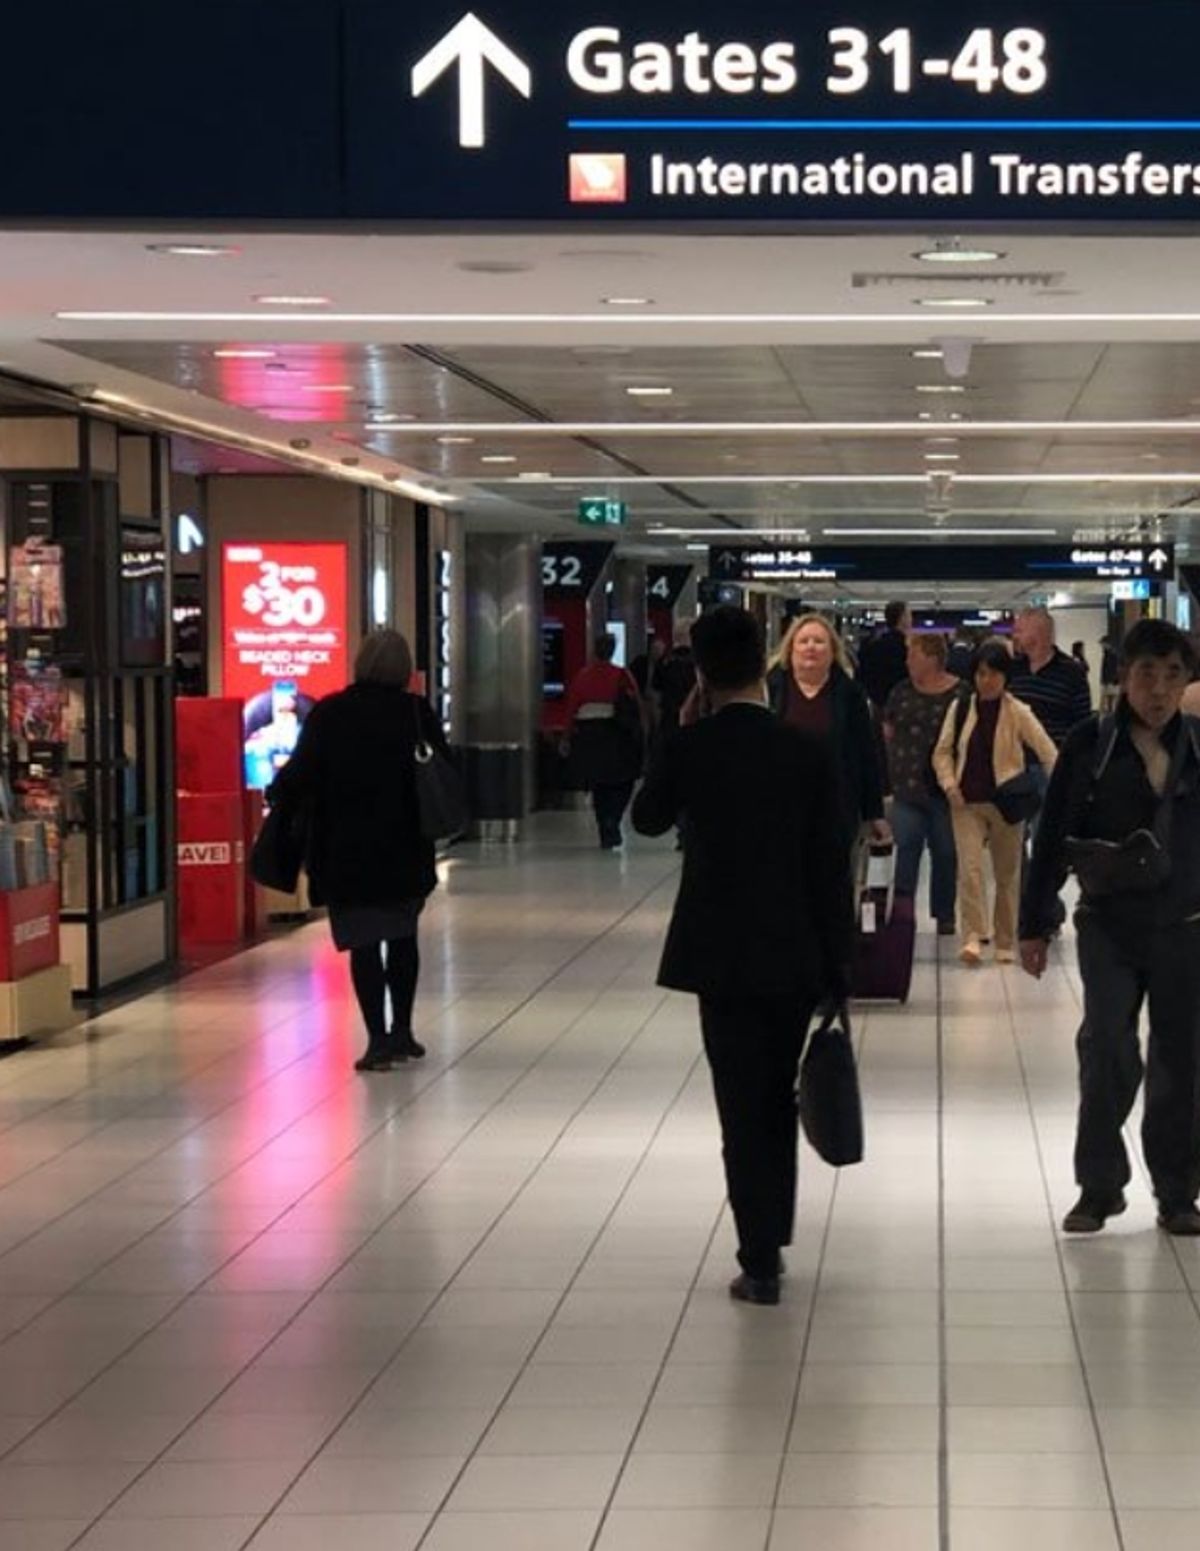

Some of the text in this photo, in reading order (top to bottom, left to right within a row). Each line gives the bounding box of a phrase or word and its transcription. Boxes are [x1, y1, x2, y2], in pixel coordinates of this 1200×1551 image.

[566, 26, 1048, 95] Gates 31-48
[651, 151, 974, 196] International
[540, 555, 582, 587] 32
[241, 583, 326, 627] $30
[177, 845, 225, 862] AVE!
